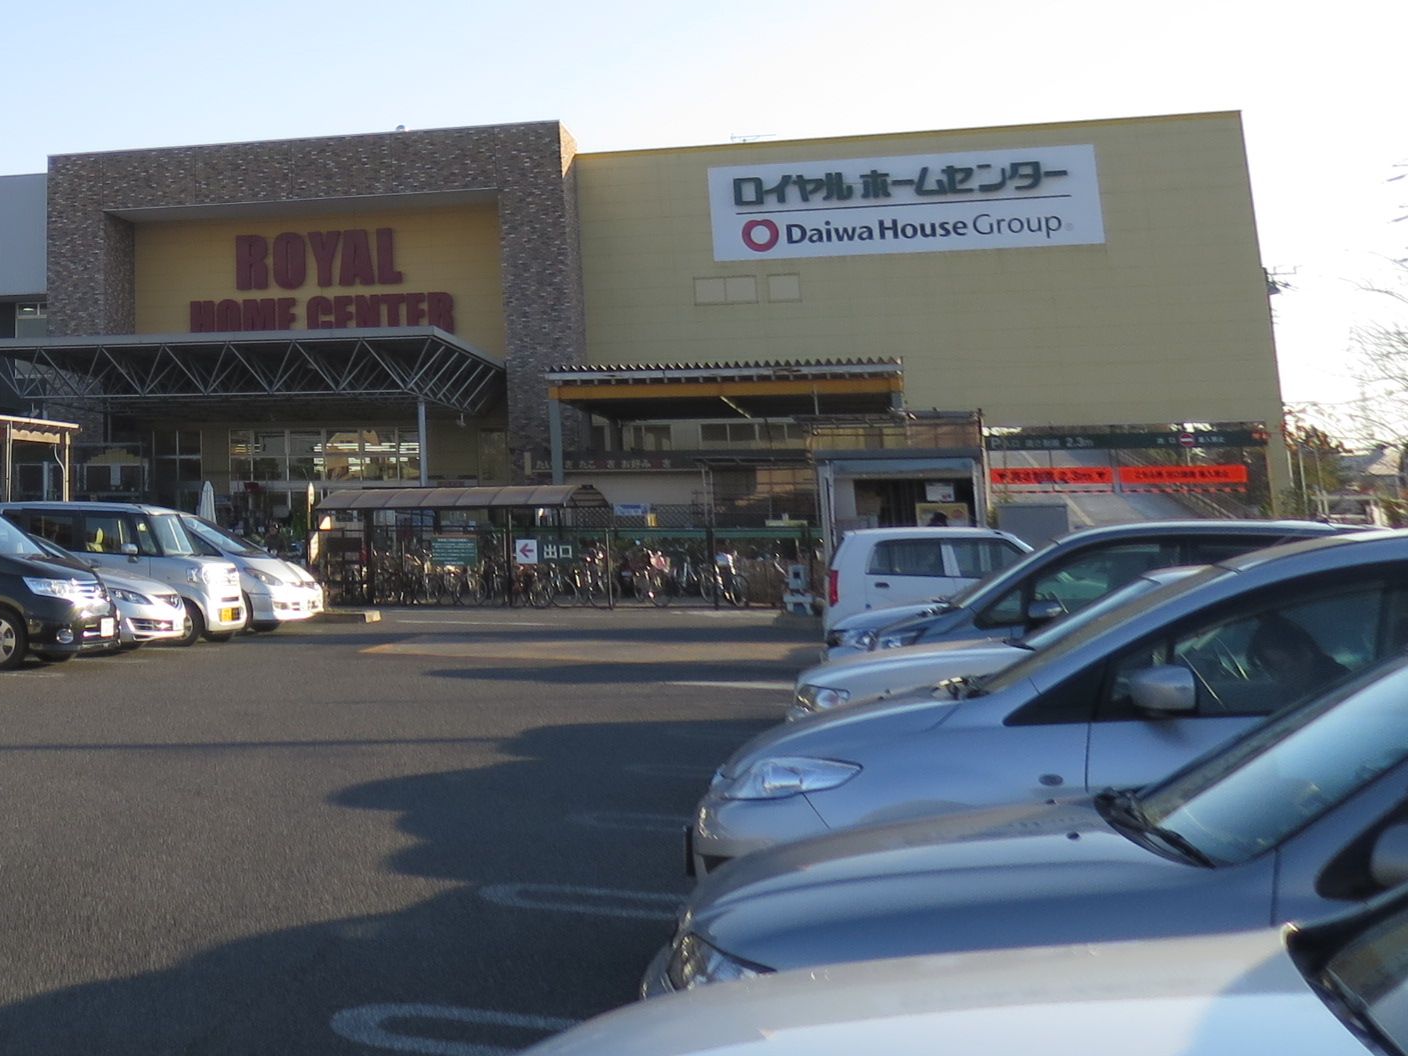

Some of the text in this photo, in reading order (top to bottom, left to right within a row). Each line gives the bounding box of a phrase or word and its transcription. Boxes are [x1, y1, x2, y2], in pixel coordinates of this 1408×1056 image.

[733, 161, 1068, 205] ロイヤルホームセンター
[786, 213, 1062, 244] Daiwa House Group
[235, 227, 403, 291] ROYAL
[190, 291, 454, 334] HOME CENTER
[543, 544, 573, 559] 出口
